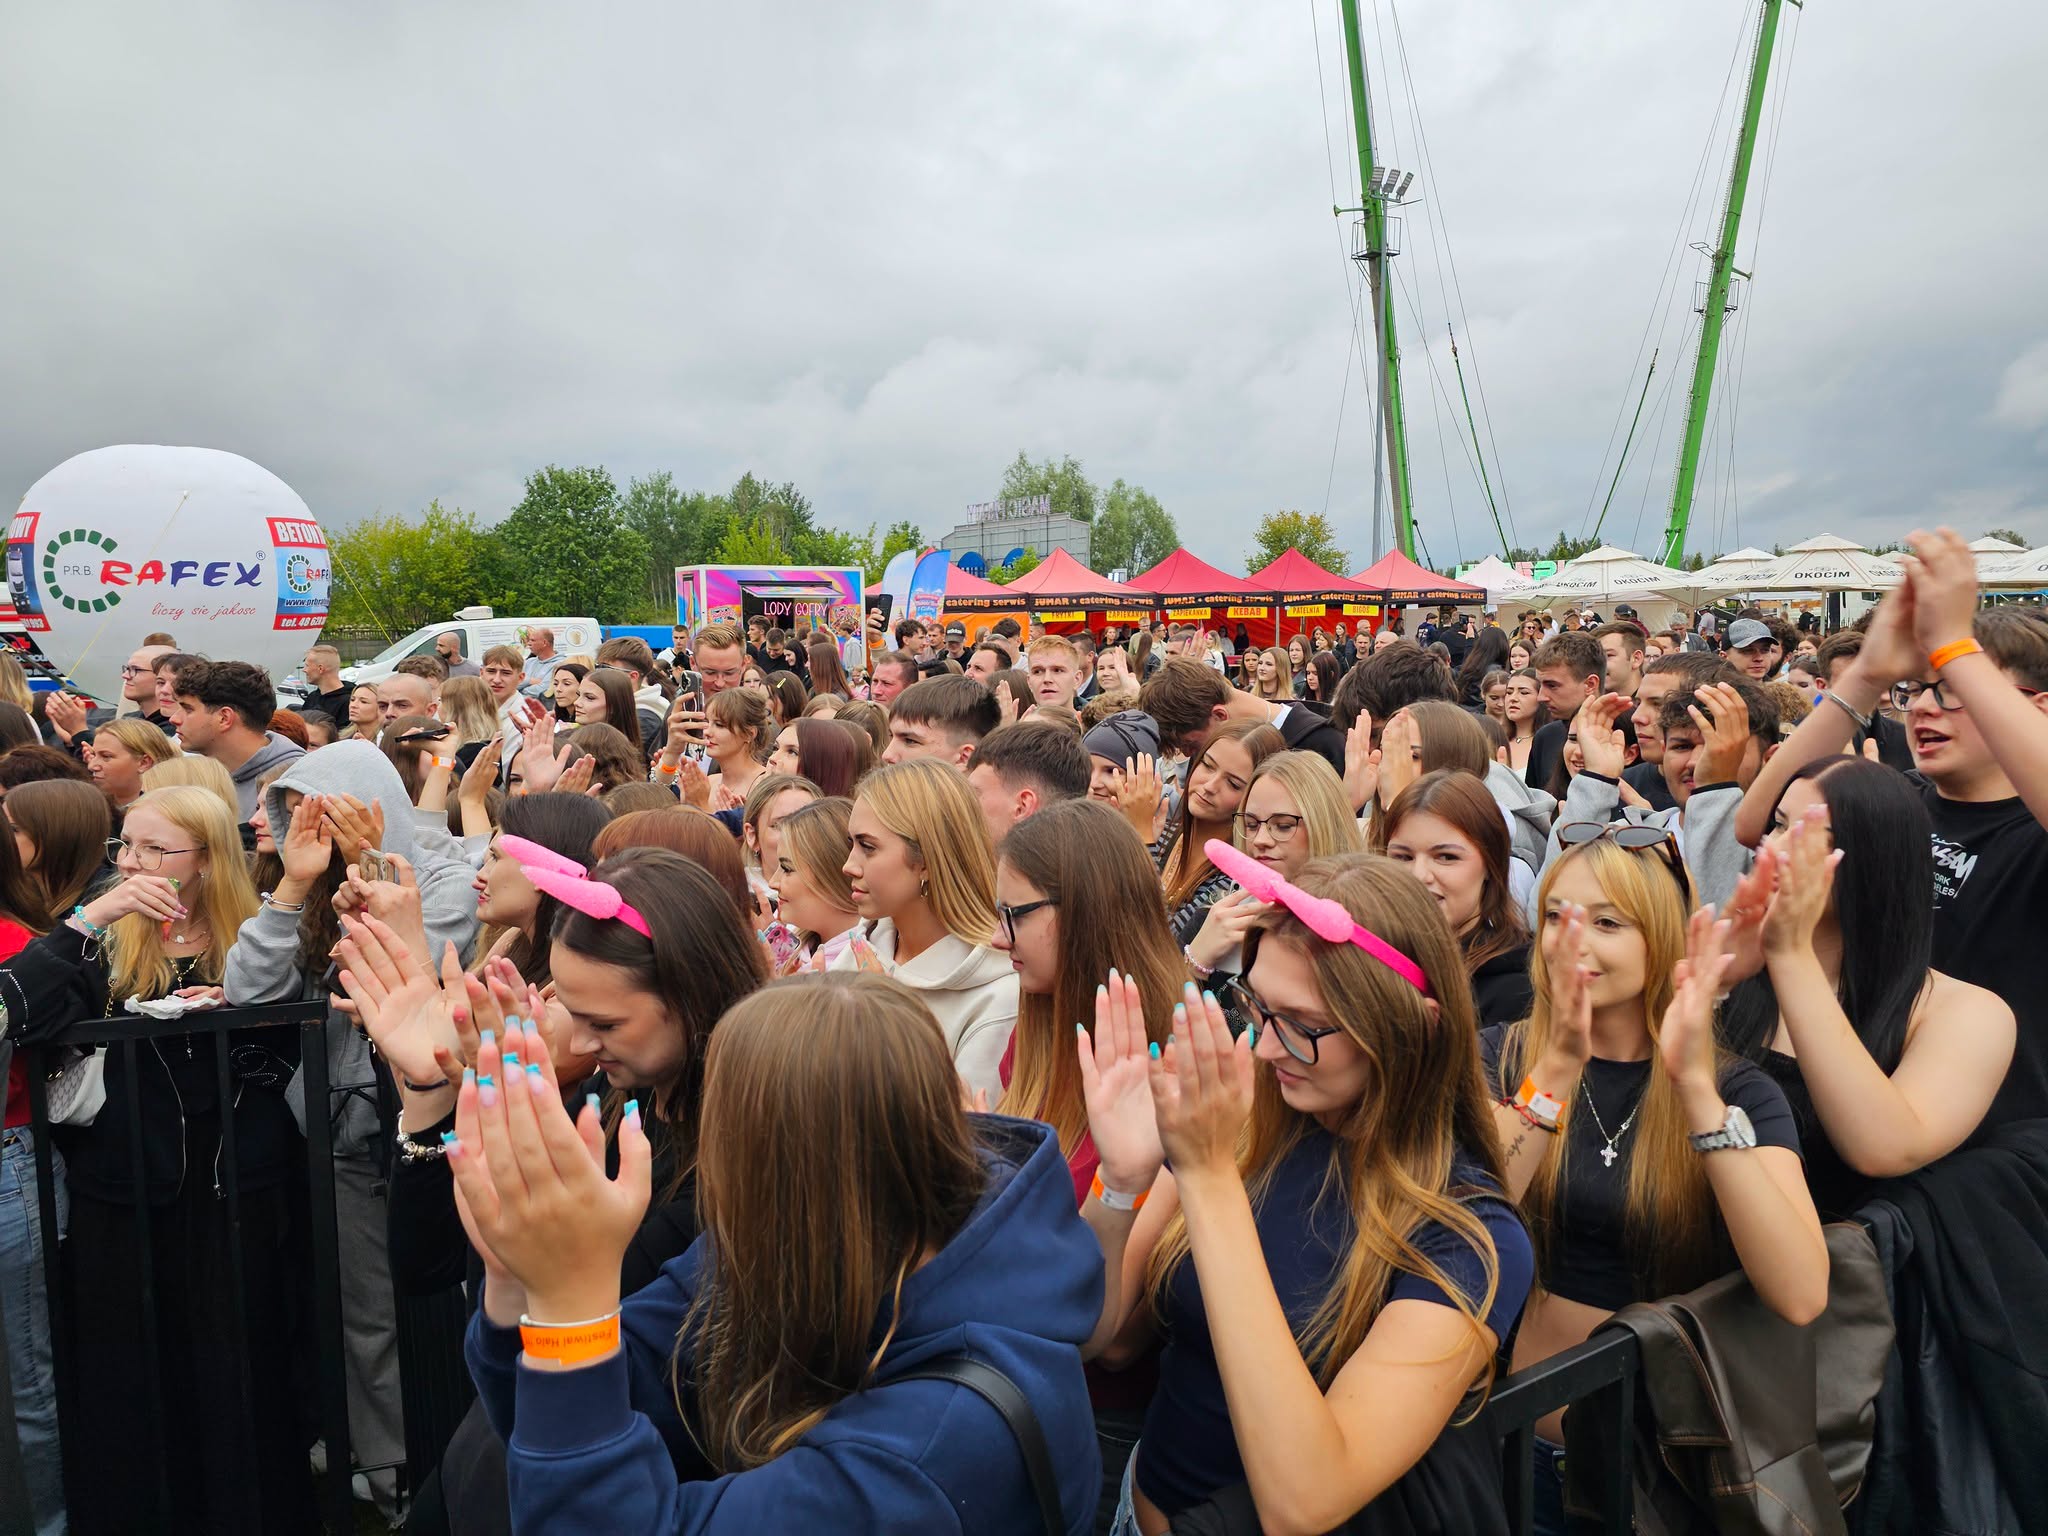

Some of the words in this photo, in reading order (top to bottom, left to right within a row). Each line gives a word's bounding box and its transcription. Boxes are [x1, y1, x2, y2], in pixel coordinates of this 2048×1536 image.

[63, 565, 94, 576] P.R.B.
[100, 559, 263, 588] RAFEX
[1794, 571, 1850, 579] OKOCIM
[1614, 576, 1661, 585] OKOCIM
[1163, 596, 1196, 606] JUMAR
[1204, 594, 1242, 603] catering
[1321, 592, 1355, 601] catering
[1391, 591, 1419, 600] JUMAR
[1427, 590, 1459, 599] catering
[1461, 591, 1485, 600] serwis
[945, 598, 990, 607] catering
[993, 597, 1026, 606] serwis
[1034, 597, 1069, 606] JUMAR
[1080, 596, 1121, 605] catering
[1123, 597, 1154, 606] serwis
[151, 602, 185, 621] liczy
[763, 601, 792, 616] LODY
[795, 601, 829, 617] GOFRY
[1172, 608, 1208, 617] ZAPIEKANKA
[1233, 607, 1262, 616] KEBAB
[1292, 606, 1320, 615] PATELNIA
[1352, 605, 1370, 614] BIGOS
[281, 618, 297, 627] tel.
[1933, 872, 1951, 886] ORK
[563, 1328, 612, 1348] Festiwal
